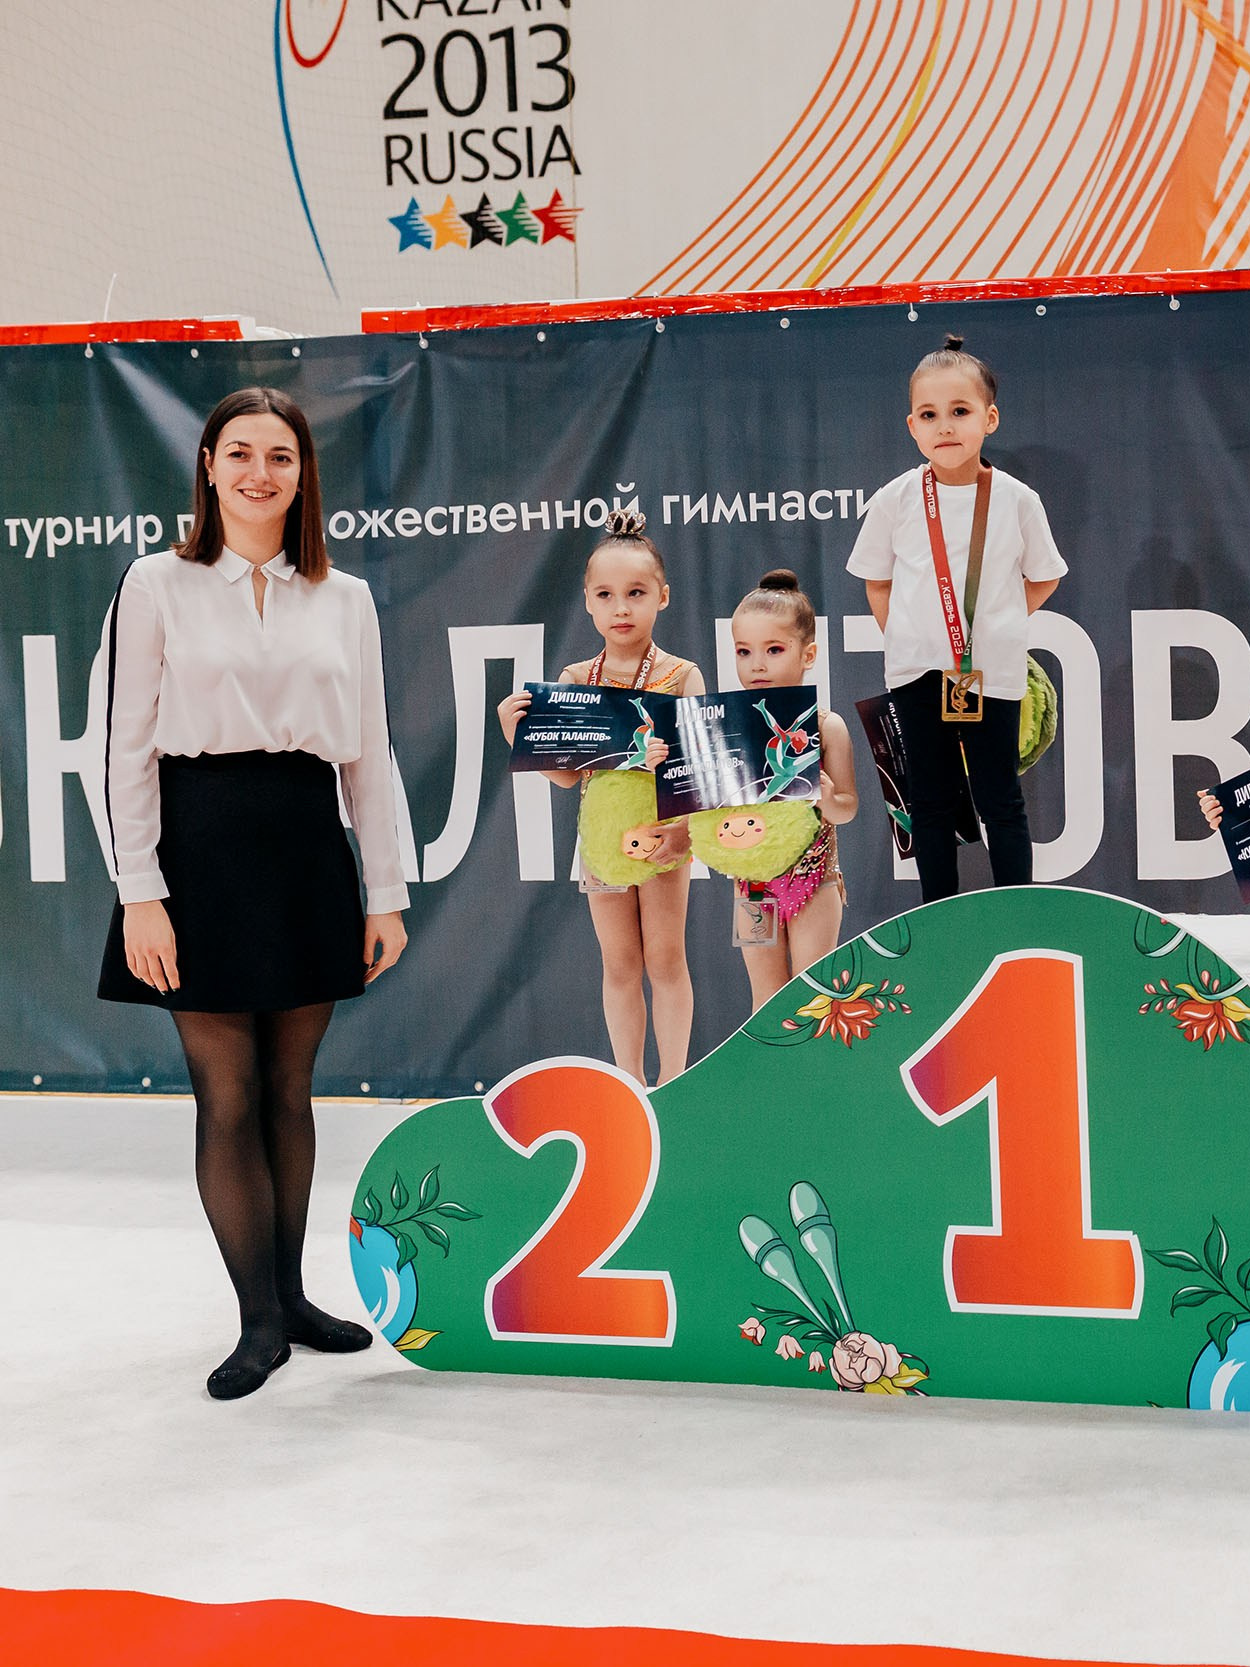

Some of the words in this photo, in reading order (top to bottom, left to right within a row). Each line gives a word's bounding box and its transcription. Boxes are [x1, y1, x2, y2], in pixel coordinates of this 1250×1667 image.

[381, 23, 576, 120] 2013
[384, 125, 581, 186] RUSSIA
[4, 513, 163, 559] турнир
[177, 514, 196, 543] п
[322, 482, 640, 544] ожественной
[662, 487, 882, 525] гимнасти
[950, 625, 964, 655] 2023
[547, 691, 602, 705] ДИПЛОМ
[523, 731, 558, 742] «КУБОК
[561, 731, 612, 742] ТАЛАНТОВ»
[900, 948, 1145, 1321] 1
[482, 1056, 677, 1348] 2
